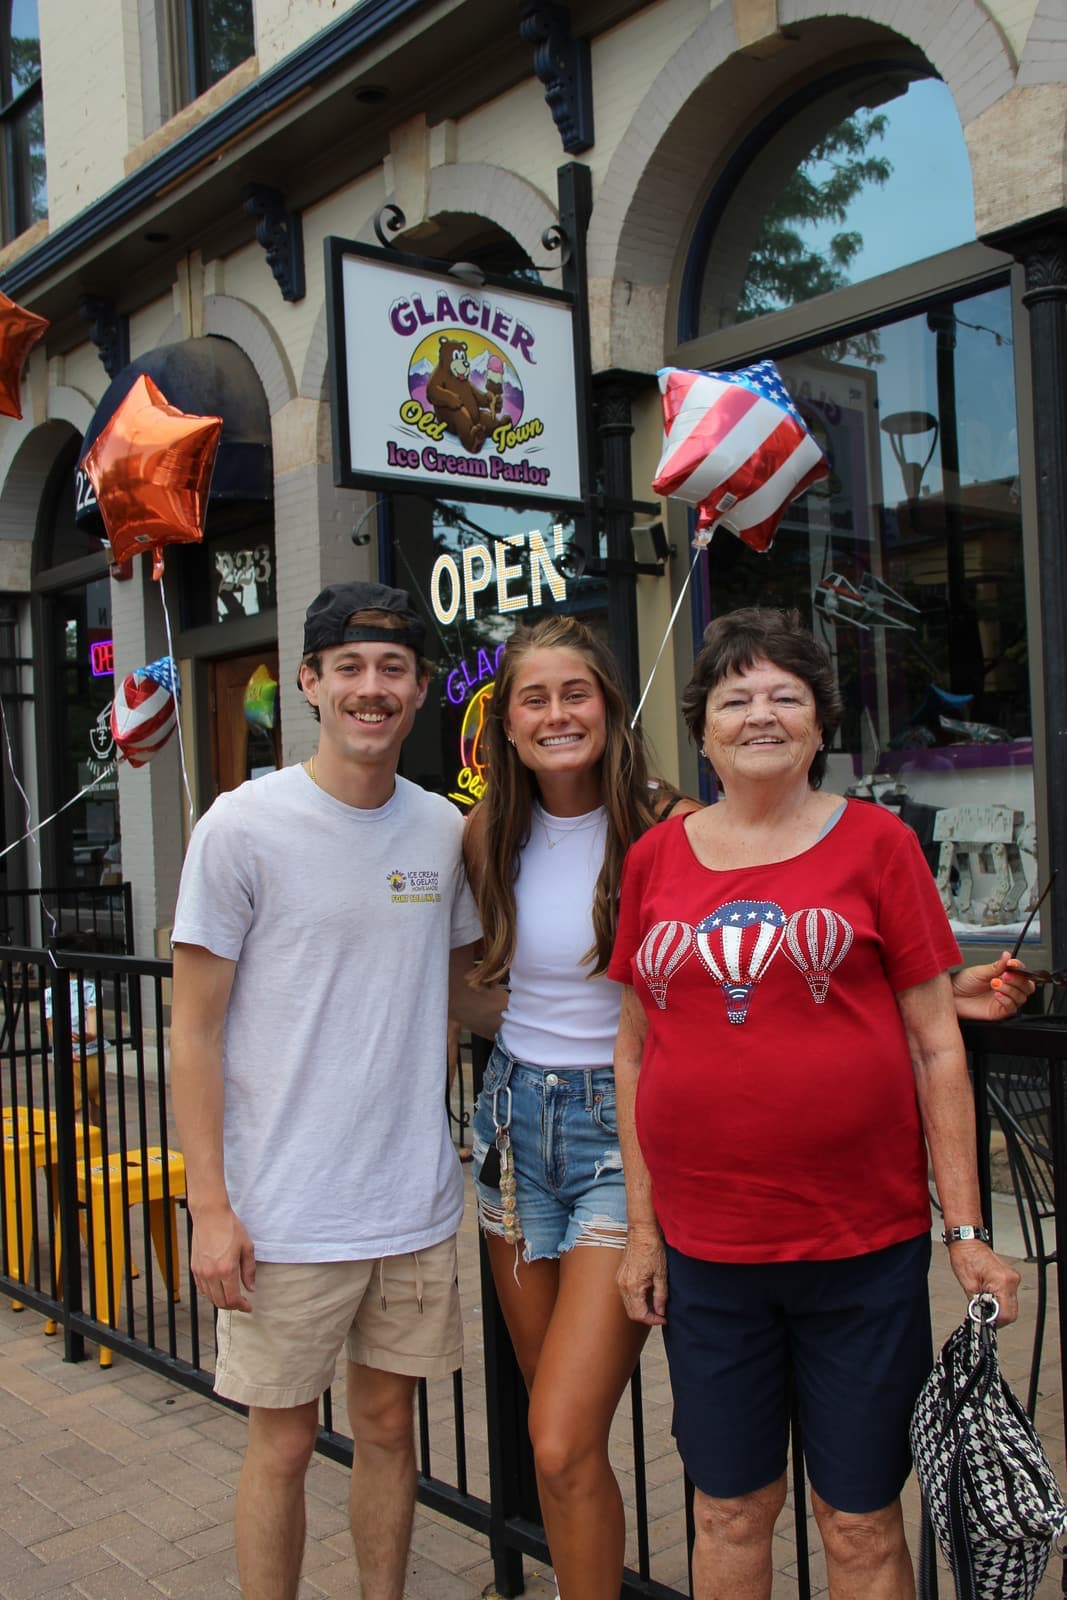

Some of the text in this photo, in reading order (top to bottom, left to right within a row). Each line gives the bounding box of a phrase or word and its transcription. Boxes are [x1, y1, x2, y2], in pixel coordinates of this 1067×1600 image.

[388, 289, 538, 365] GLACIER
[400, 399, 544, 453] Old Town
[387, 441, 550, 486] Ice Cream Parlor
[430, 523, 567, 625] OPEN
[407, 871, 418, 879] ICE
[418, 871, 439, 879] CREAM
[410, 878, 439, 887] & GELATO
